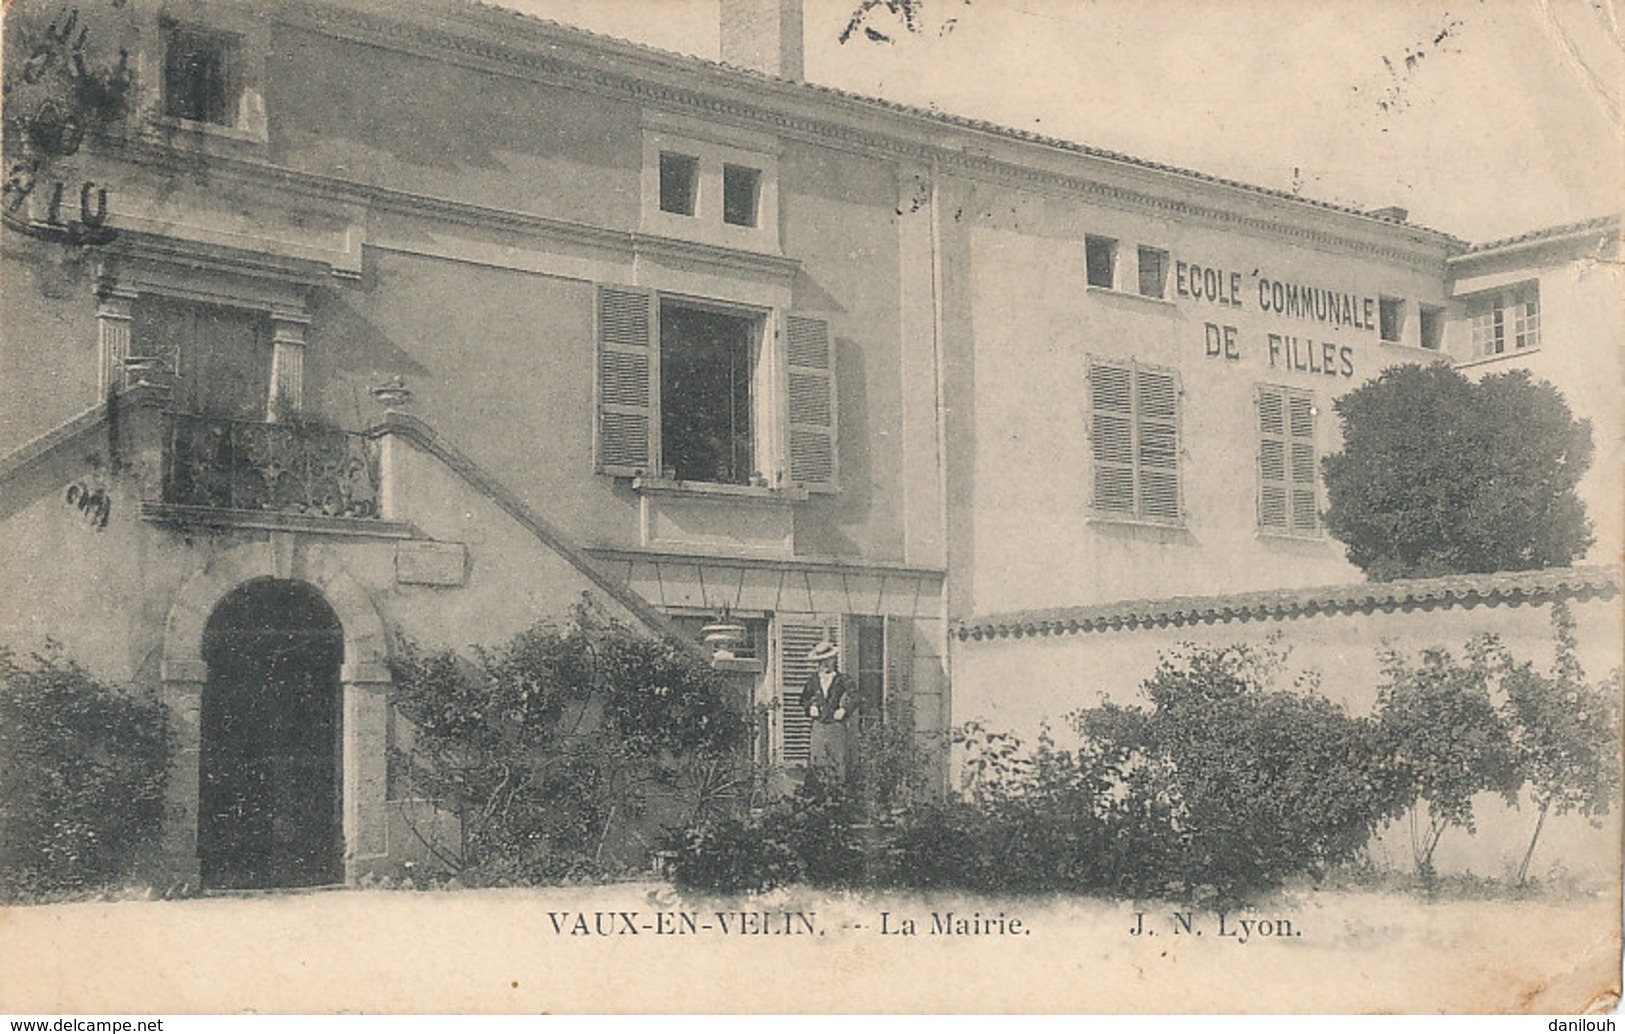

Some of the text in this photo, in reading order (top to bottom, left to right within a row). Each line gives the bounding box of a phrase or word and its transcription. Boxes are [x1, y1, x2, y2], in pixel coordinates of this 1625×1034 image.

[1176, 260, 1375, 331] ECOLE COMMUNALE
[1205, 322, 1354, 377] DE FILLES
